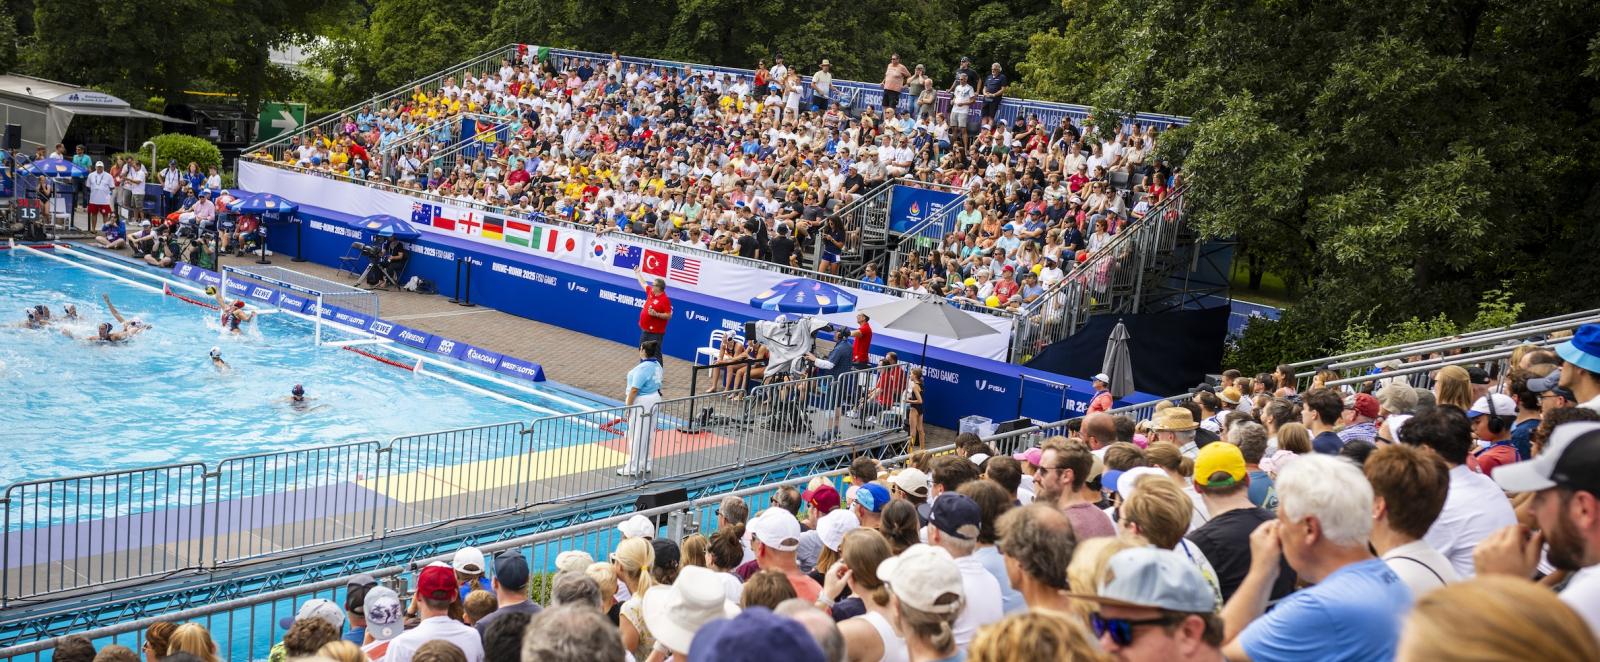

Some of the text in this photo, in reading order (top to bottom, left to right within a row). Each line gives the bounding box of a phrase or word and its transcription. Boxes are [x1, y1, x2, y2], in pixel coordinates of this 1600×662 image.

[21, 208, 36, 219] 15
[424, 246, 436, 257] 2025
[443, 250, 454, 261] GAMES
[492, 262, 522, 277] RHINE-RUHR
[522, 270, 536, 281] 2025
[544, 275, 557, 286] GAMES
[254, 288, 271, 299] REWE
[599, 289, 646, 308] RHINE-RUHR 202
[408, 333, 425, 344] RIEDEL
[472, 351, 497, 364] QIAODAN
[928, 367, 940, 379] FISU
[940, 370, 959, 384] GAMES
[988, 384, 1006, 393] FISU
